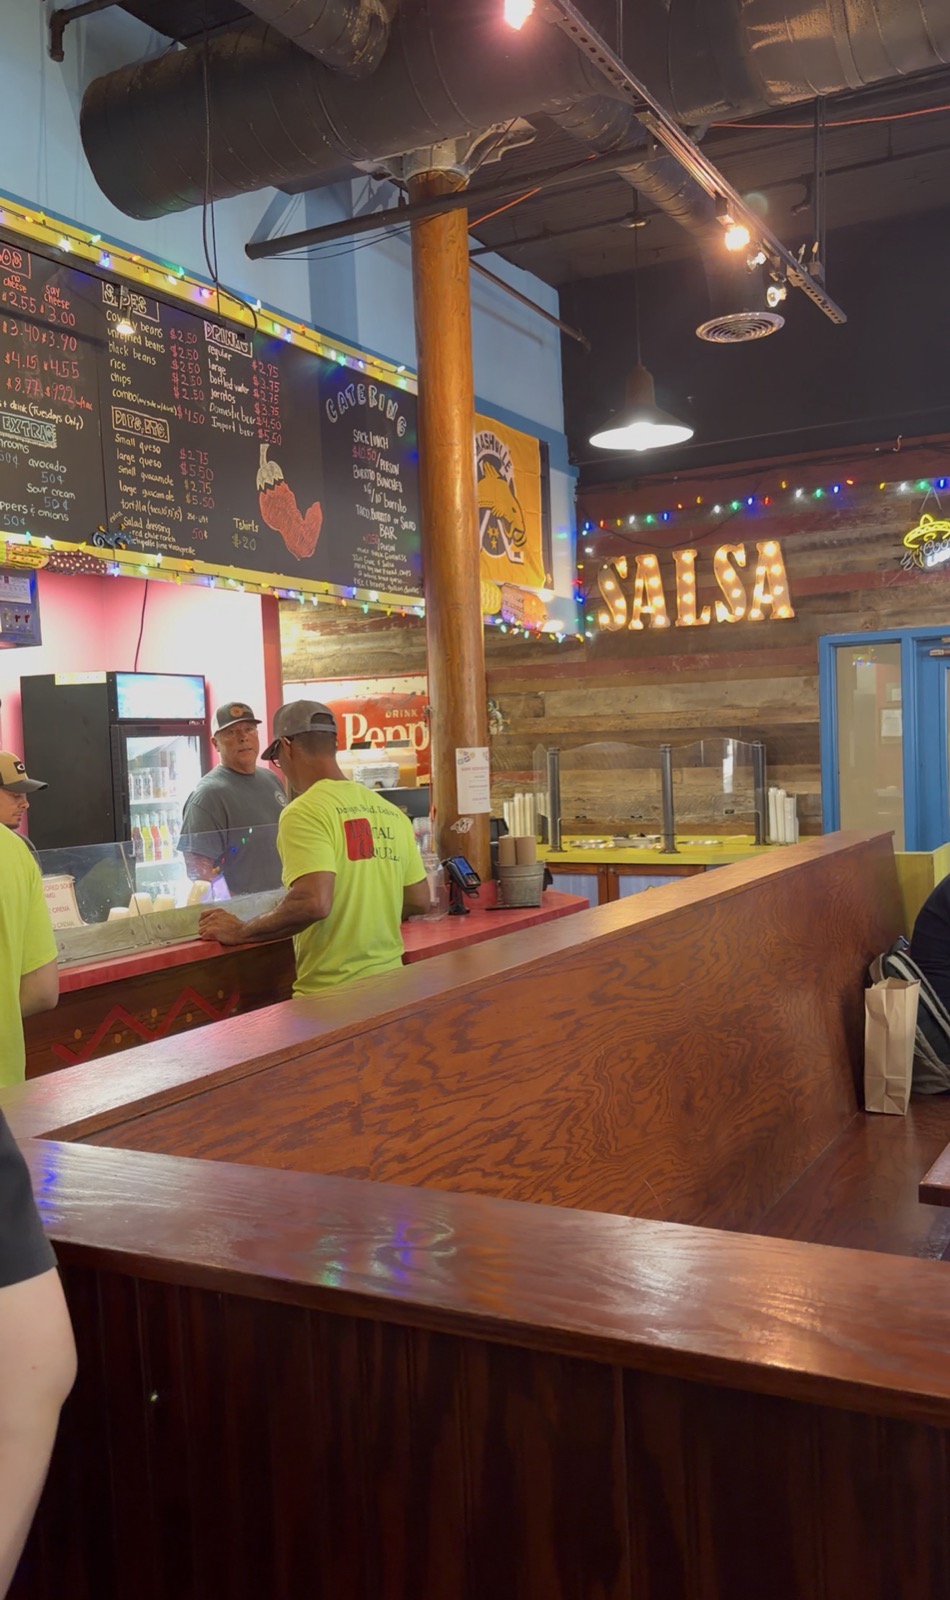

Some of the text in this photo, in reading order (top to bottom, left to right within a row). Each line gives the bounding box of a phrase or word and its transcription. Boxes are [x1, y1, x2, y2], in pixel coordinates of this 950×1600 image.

[0, 248, 22, 268] OS
[140, 321, 163, 339] beans
[108, 341, 129, 357] black
[133, 348, 157, 366] beans
[144, 336, 165, 354] beans
[207, 345, 232, 361] regular
[110, 358, 127, 371] rice
[110, 372, 132, 387] chips
[209, 371, 233, 391] bottled
[325, 383, 407, 437] CATERING
[139, 442, 161, 454] queso
[28, 458, 67, 473] avocado
[116, 448, 136, 466] large
[139, 456, 162, 469] queso
[51, 489, 76, 499] cream
[119, 479, 137, 496] large
[38, 509, 69, 521] onions
[379, 523, 398, 540] BAR
[597, 540, 796, 632] SALSA
[385, 709, 418, 718] DRINK
